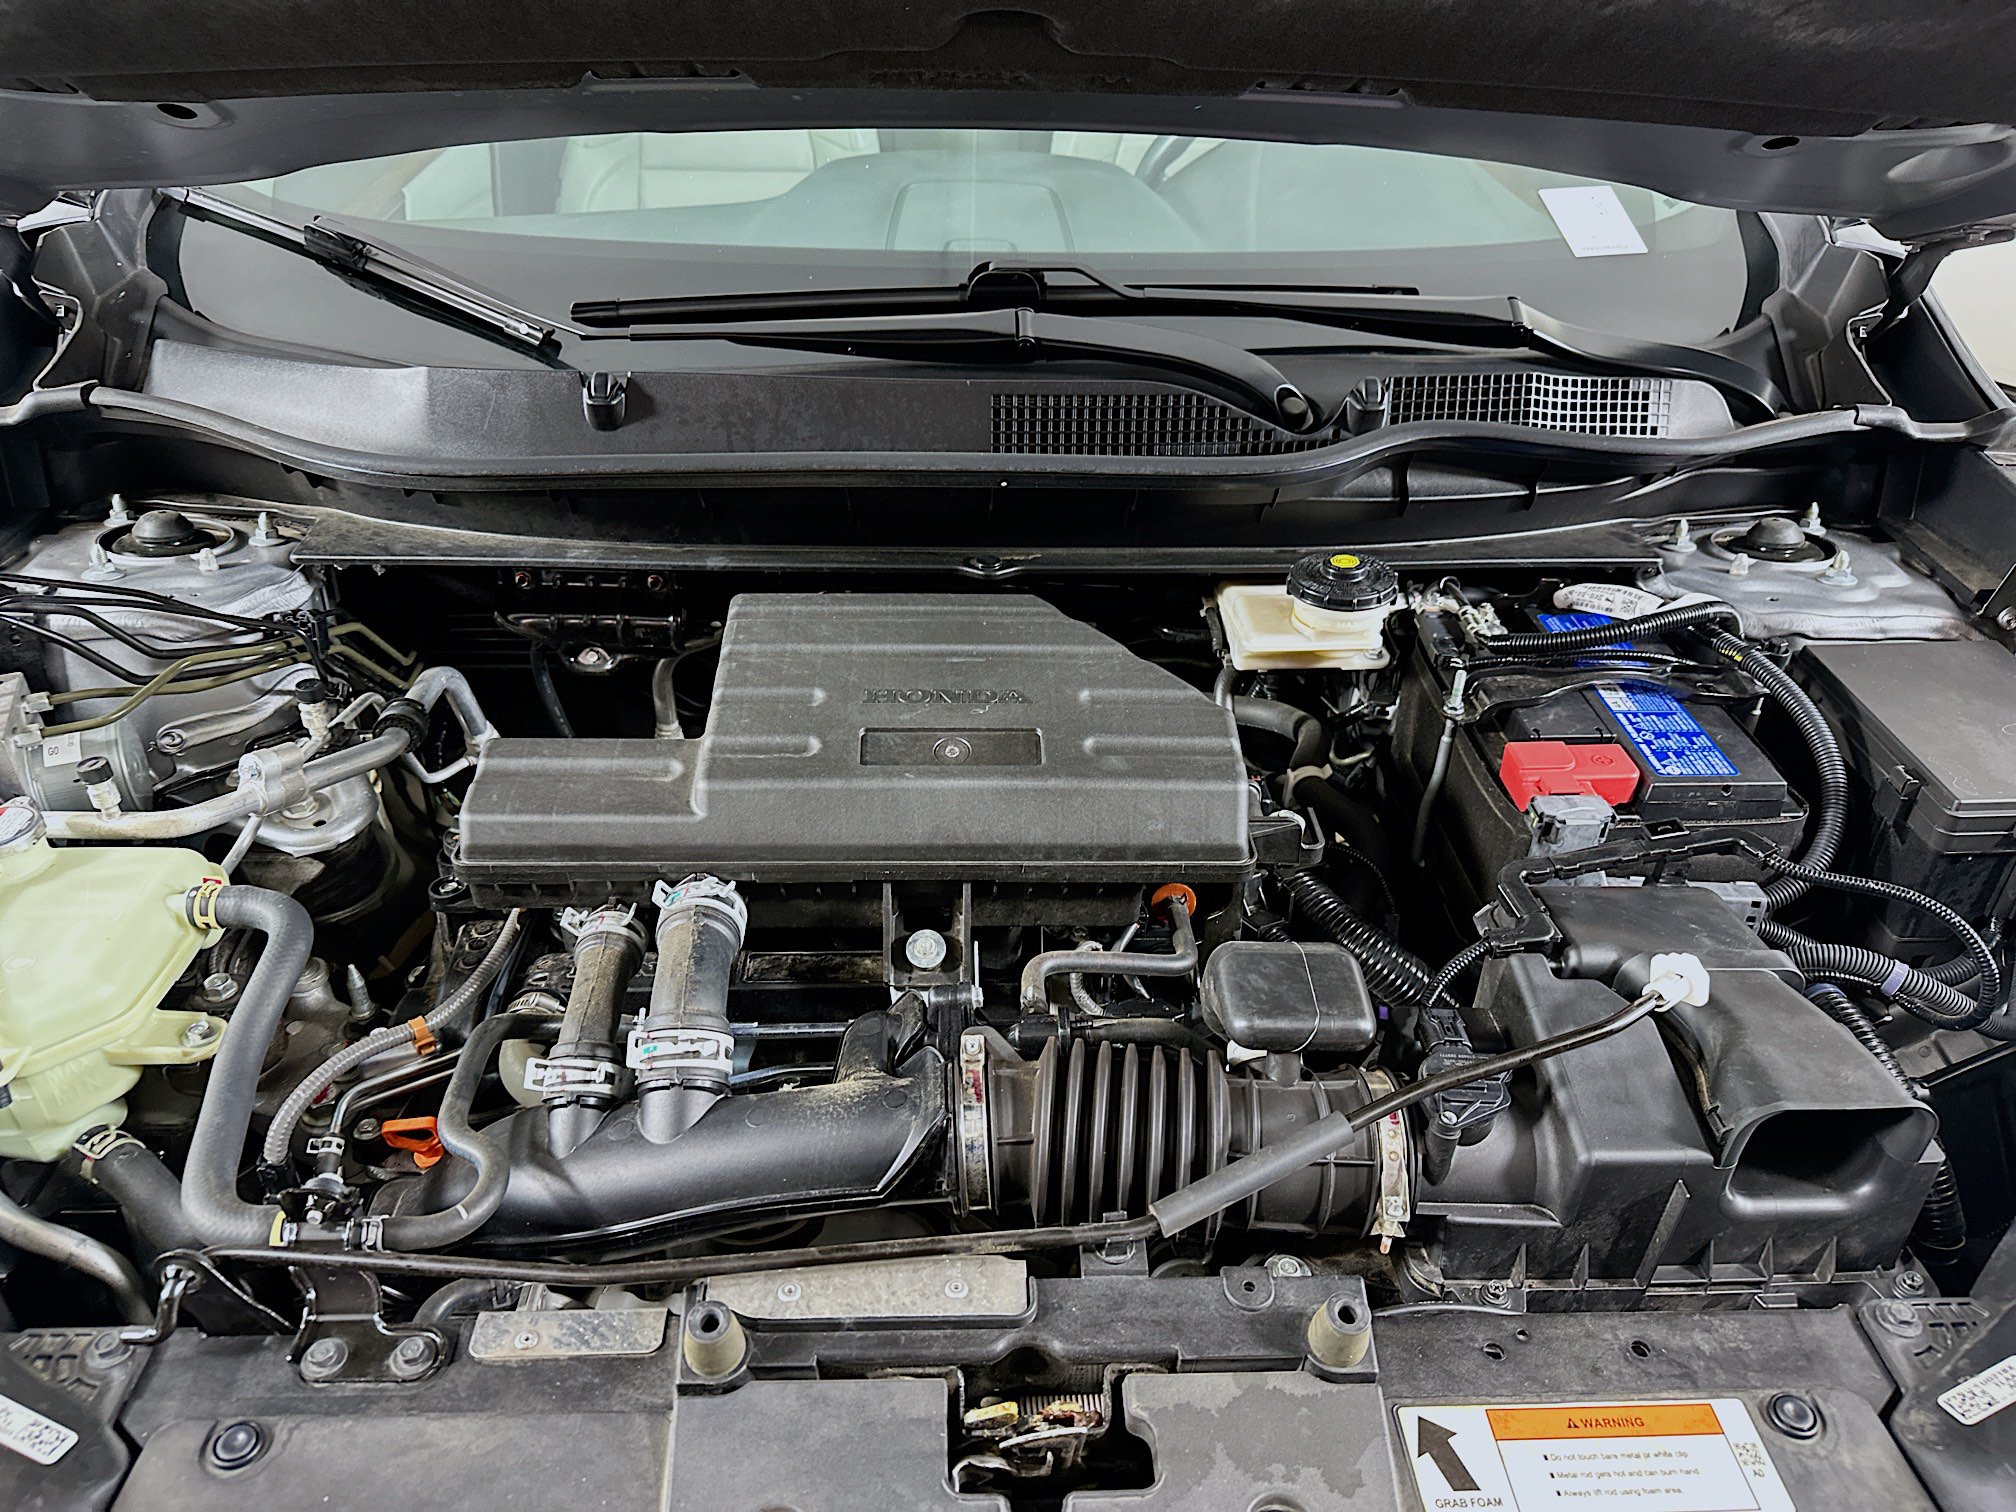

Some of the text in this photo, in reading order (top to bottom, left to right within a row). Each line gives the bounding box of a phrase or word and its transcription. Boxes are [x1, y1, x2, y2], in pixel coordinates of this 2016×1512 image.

[862, 688, 1034, 705] HONDA
[1580, 1417, 1645, 1428] WARNING
[1550, 1453, 1562, 1461] Do
[1564, 1453, 1576, 1461] not
[1577, 1453, 1599, 1461] touch
[1600, 1452, 1618, 1460] bare
[1556, 1471, 1578, 1479] Metal
[1595, 1471, 1612, 1479] gets
[1564, 1489, 1592, 1498] Always
[1593, 1488, 1602, 1496] lift
[1619, 1488, 1641, 1496] using
[1642, 1487, 1662, 1495] foam
[1435, 1497, 1503, 1508] GRAB FOAM
